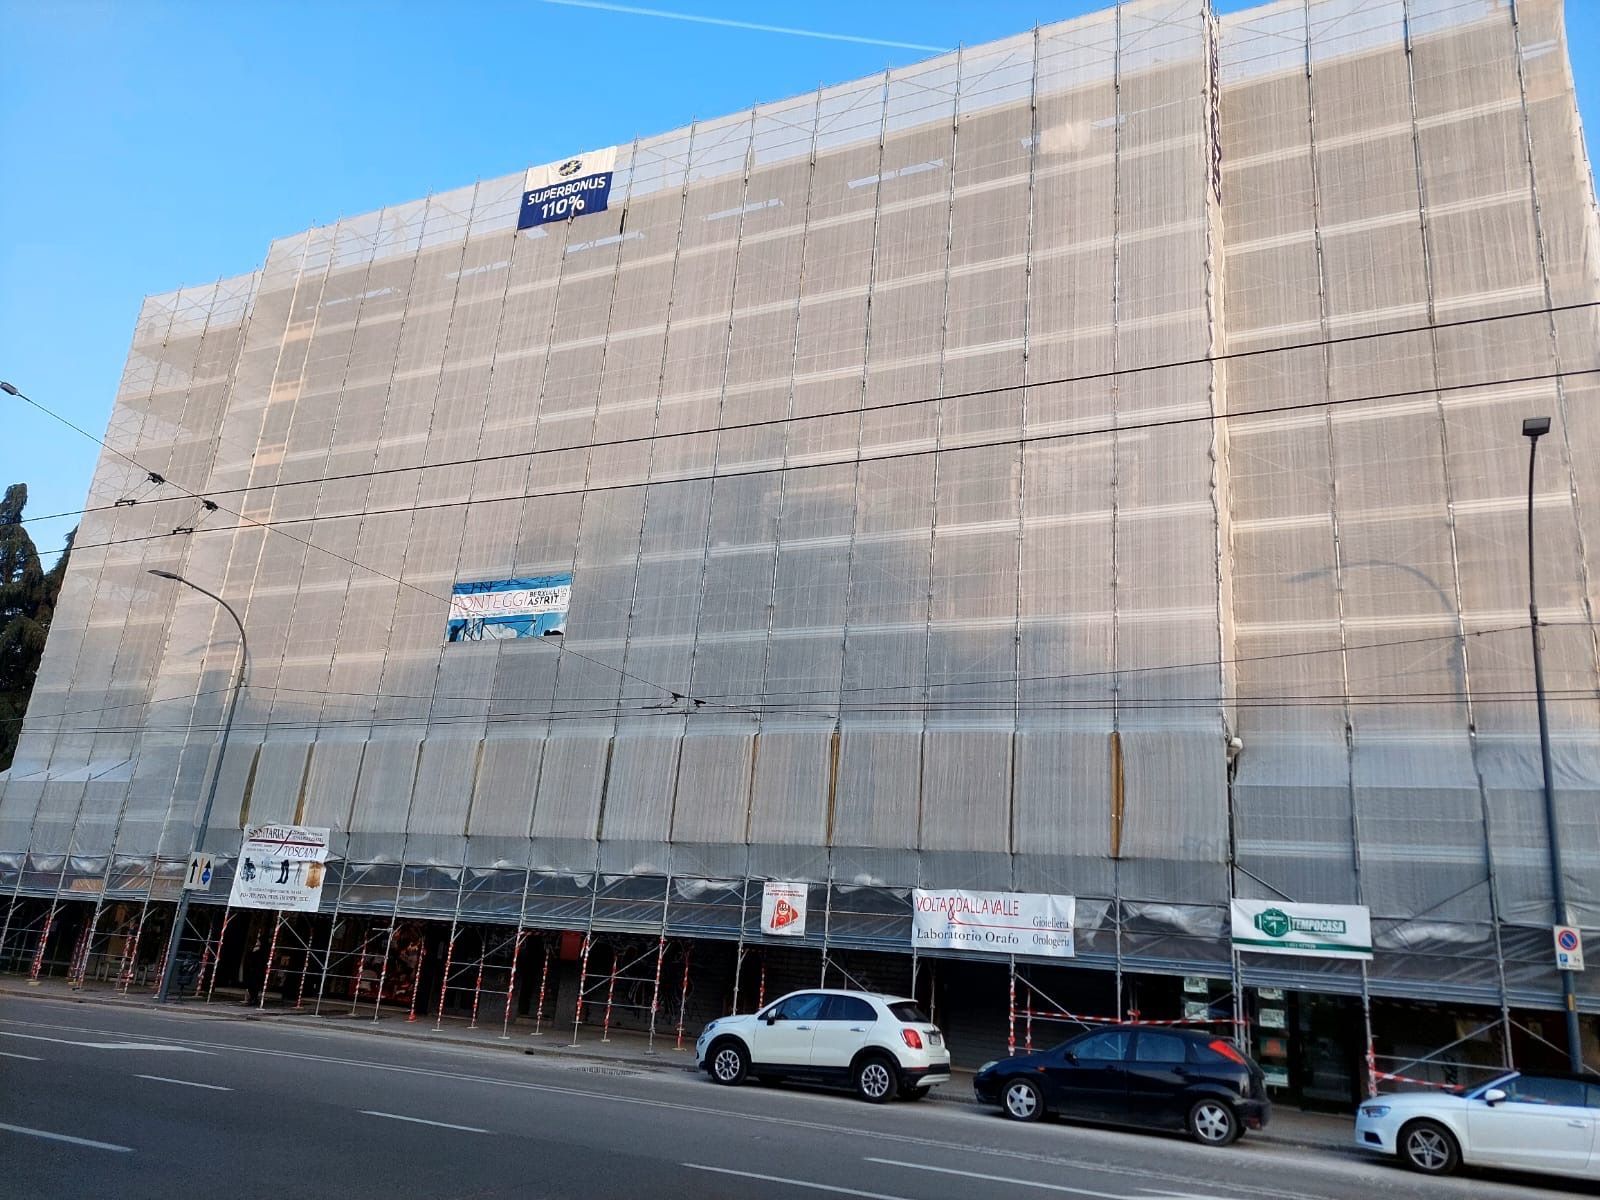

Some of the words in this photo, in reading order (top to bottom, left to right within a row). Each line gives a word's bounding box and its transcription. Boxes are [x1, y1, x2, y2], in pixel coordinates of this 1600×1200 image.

[527, 176, 606, 206] SUPERBONUS
[541, 194, 585, 219] 110%
[527, 595, 560, 606] ASTRIT
[248, 827, 285, 840] SANITARIA
[284, 845, 319, 859] TOSCANA
[915, 896, 948, 912] VOLTA
[955, 898, 988, 915] DALLA
[990, 899, 1019, 916] VALLE
[1032, 915, 1070, 929] Gioielleria
[1291, 919, 1344, 933] TEMPOCASA
[917, 928, 982, 942] Laboratorio
[985, 931, 1019, 945] Orafo
[1032, 933, 1070, 950] Orologeria
